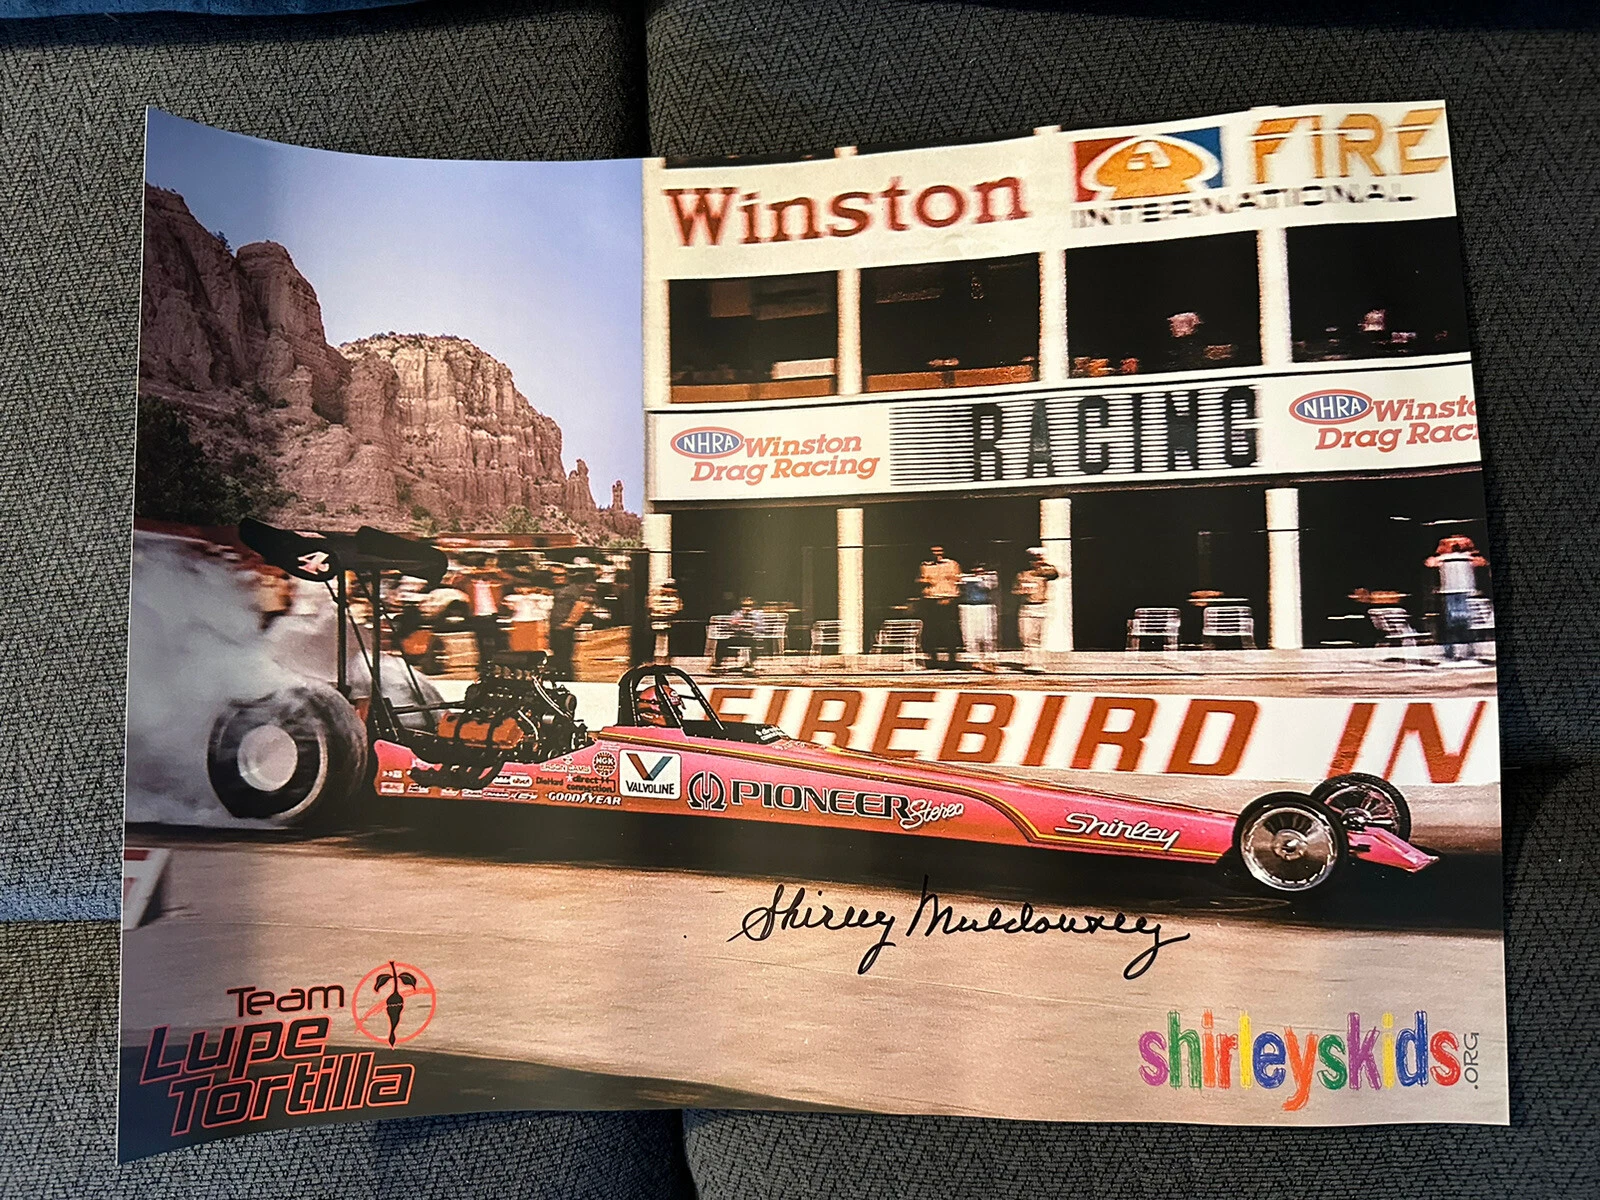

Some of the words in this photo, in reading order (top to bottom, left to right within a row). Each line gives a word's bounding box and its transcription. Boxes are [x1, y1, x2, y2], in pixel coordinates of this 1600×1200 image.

[663, 176, 1031, 246] Winston
[1071, 184, 1416, 227] INTERNATIONAL
[1301, 396, 1362, 420] NHRA
[682, 431, 736, 454] NHRA
[744, 433, 862, 458] Winston
[972, 385, 1257, 481] RACING
[1315, 427, 1402, 453] Drag
[690, 461, 767, 486] Drag
[770, 455, 880, 480] Racing
[596, 757, 614, 765] NGK
[1327, 701, 1487, 783] IN
[548, 791, 621, 806] GOODYEAR
[626, 780, 675, 795] VALVOLINE
[731, 779, 910, 820] PIONEER
[900, 800, 963, 829] Stereo
[1055, 813, 1182, 850] Shirley
[726, 883, 896, 975] Shirley
[227, 984, 345, 1017] Team
[139, 1015, 332, 1086] Lupe
[1138, 1010, 1461, 1111] shirleyskids
[168, 1051, 415, 1137] Tortilla
